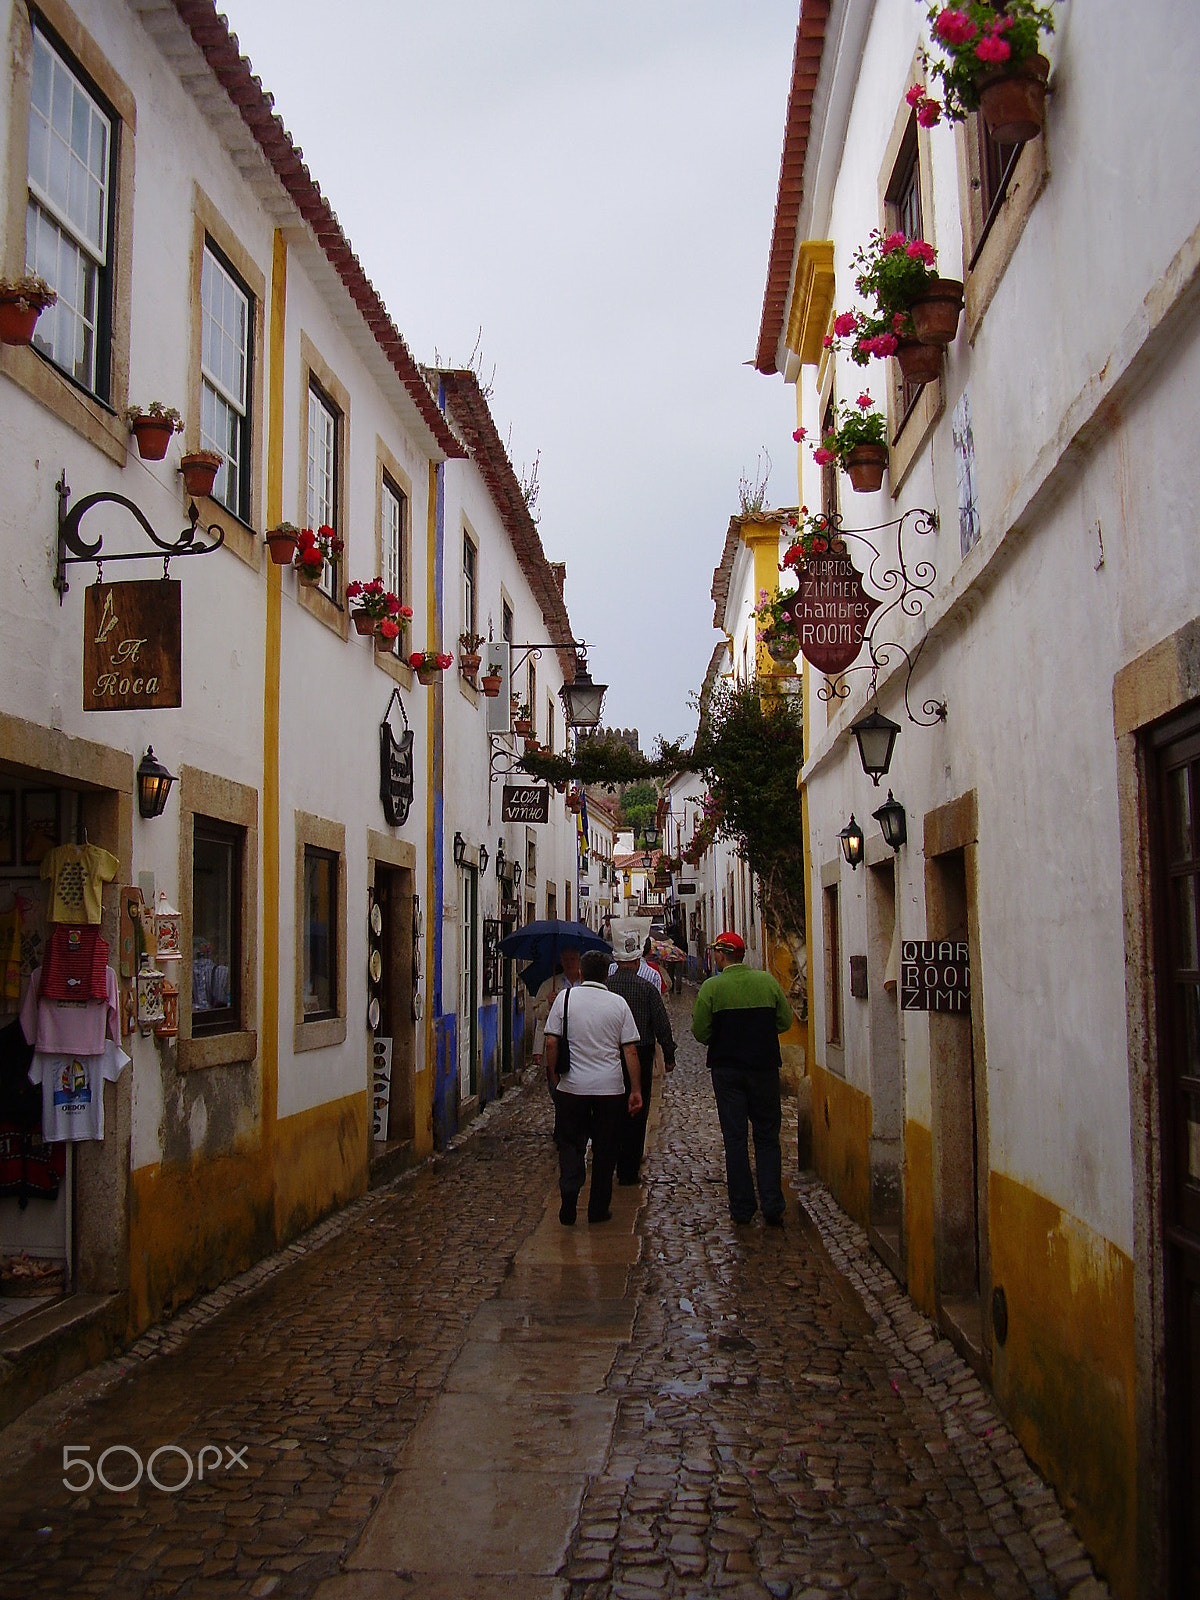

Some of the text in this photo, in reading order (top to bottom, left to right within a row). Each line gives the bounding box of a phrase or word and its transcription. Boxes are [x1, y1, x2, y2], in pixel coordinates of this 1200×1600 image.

[808, 560, 853, 576] QUARTOS
[804, 581, 859, 597] ZIMMER
[802, 623, 863, 645] ROOMS
[110, 638, 148, 665] A
[92, 671, 160, 697] Roca
[903, 941, 969, 962] QUAR
